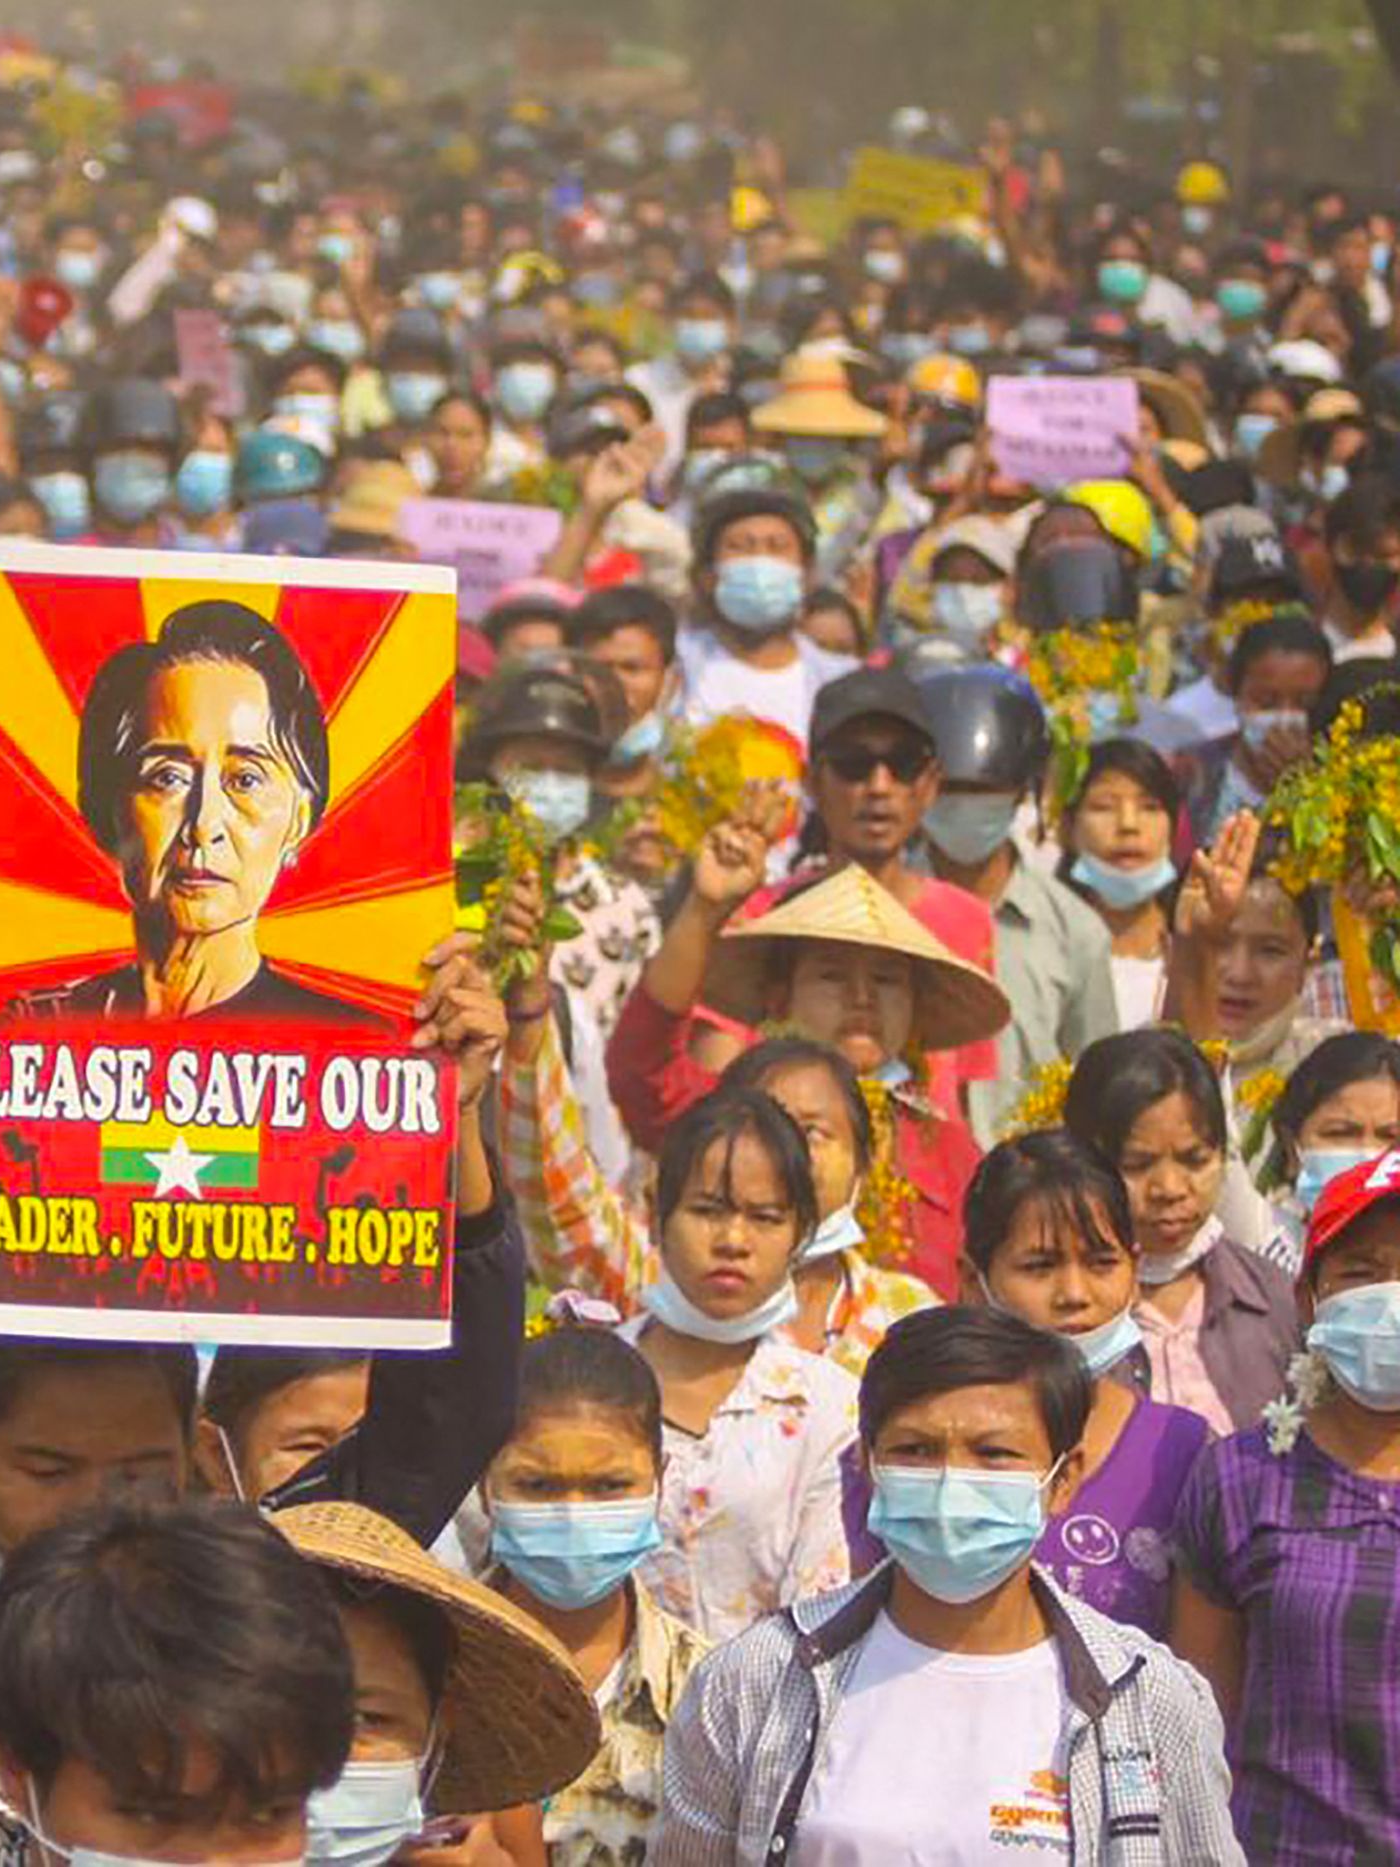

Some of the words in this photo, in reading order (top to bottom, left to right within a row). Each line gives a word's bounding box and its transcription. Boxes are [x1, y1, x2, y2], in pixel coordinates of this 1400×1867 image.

[165, 1050, 306, 1126] SAVE
[320, 1056, 440, 1133] OUR
[132, 1202, 296, 1262] FUTURE
[326, 1207, 440, 1266] HOPE
